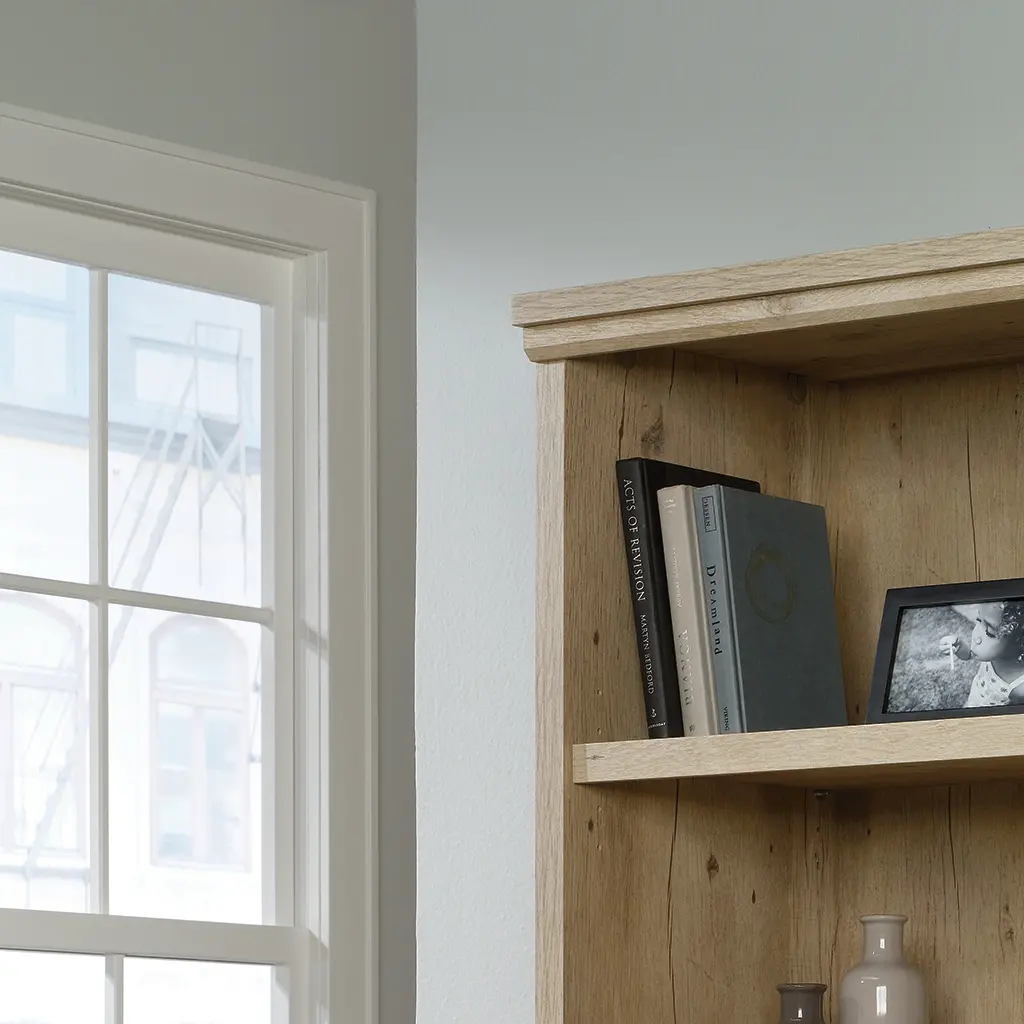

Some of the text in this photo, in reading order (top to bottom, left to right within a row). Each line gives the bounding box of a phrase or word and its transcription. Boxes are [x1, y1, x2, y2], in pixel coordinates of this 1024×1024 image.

[623, 478, 646, 601] ACTS OF REVISION
[640, 613, 650, 650] MARTYN
